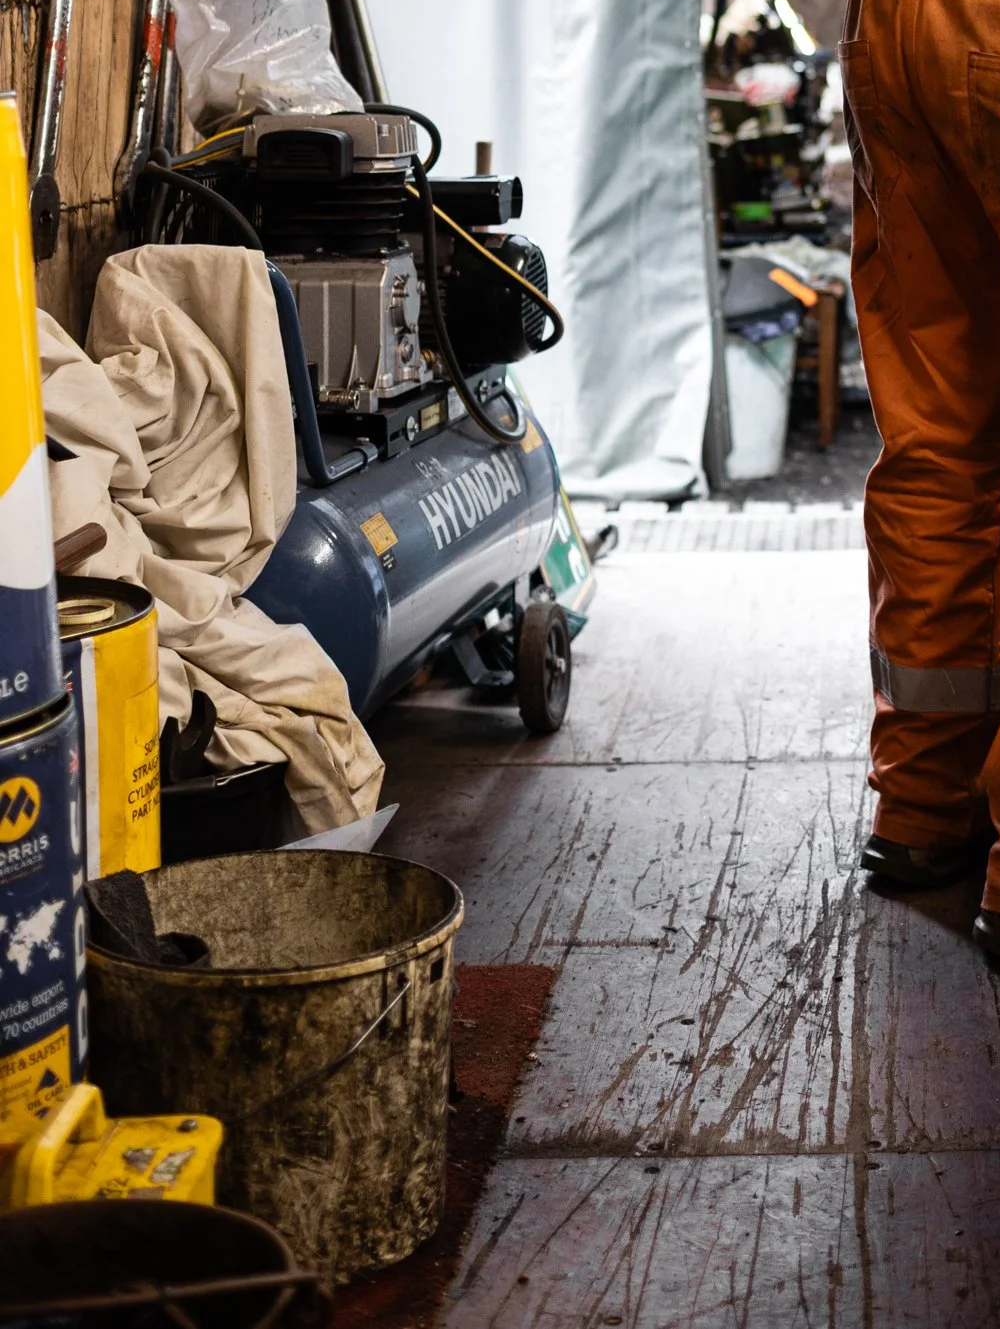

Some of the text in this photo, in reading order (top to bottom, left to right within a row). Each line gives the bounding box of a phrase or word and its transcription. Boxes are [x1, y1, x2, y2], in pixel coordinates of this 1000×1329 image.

[418, 452, 523, 551] HYUNDAI
[133, 757, 160, 783] STRAIG
[127, 773, 160, 805] CYLIND
[132, 800, 151, 823] PART
[0, 834, 49, 867] ORRIS
[0, 980, 65, 1021] wide export
[3, 997, 69, 1041] 70 countries
[29, 1033, 67, 1065] SAFETY
